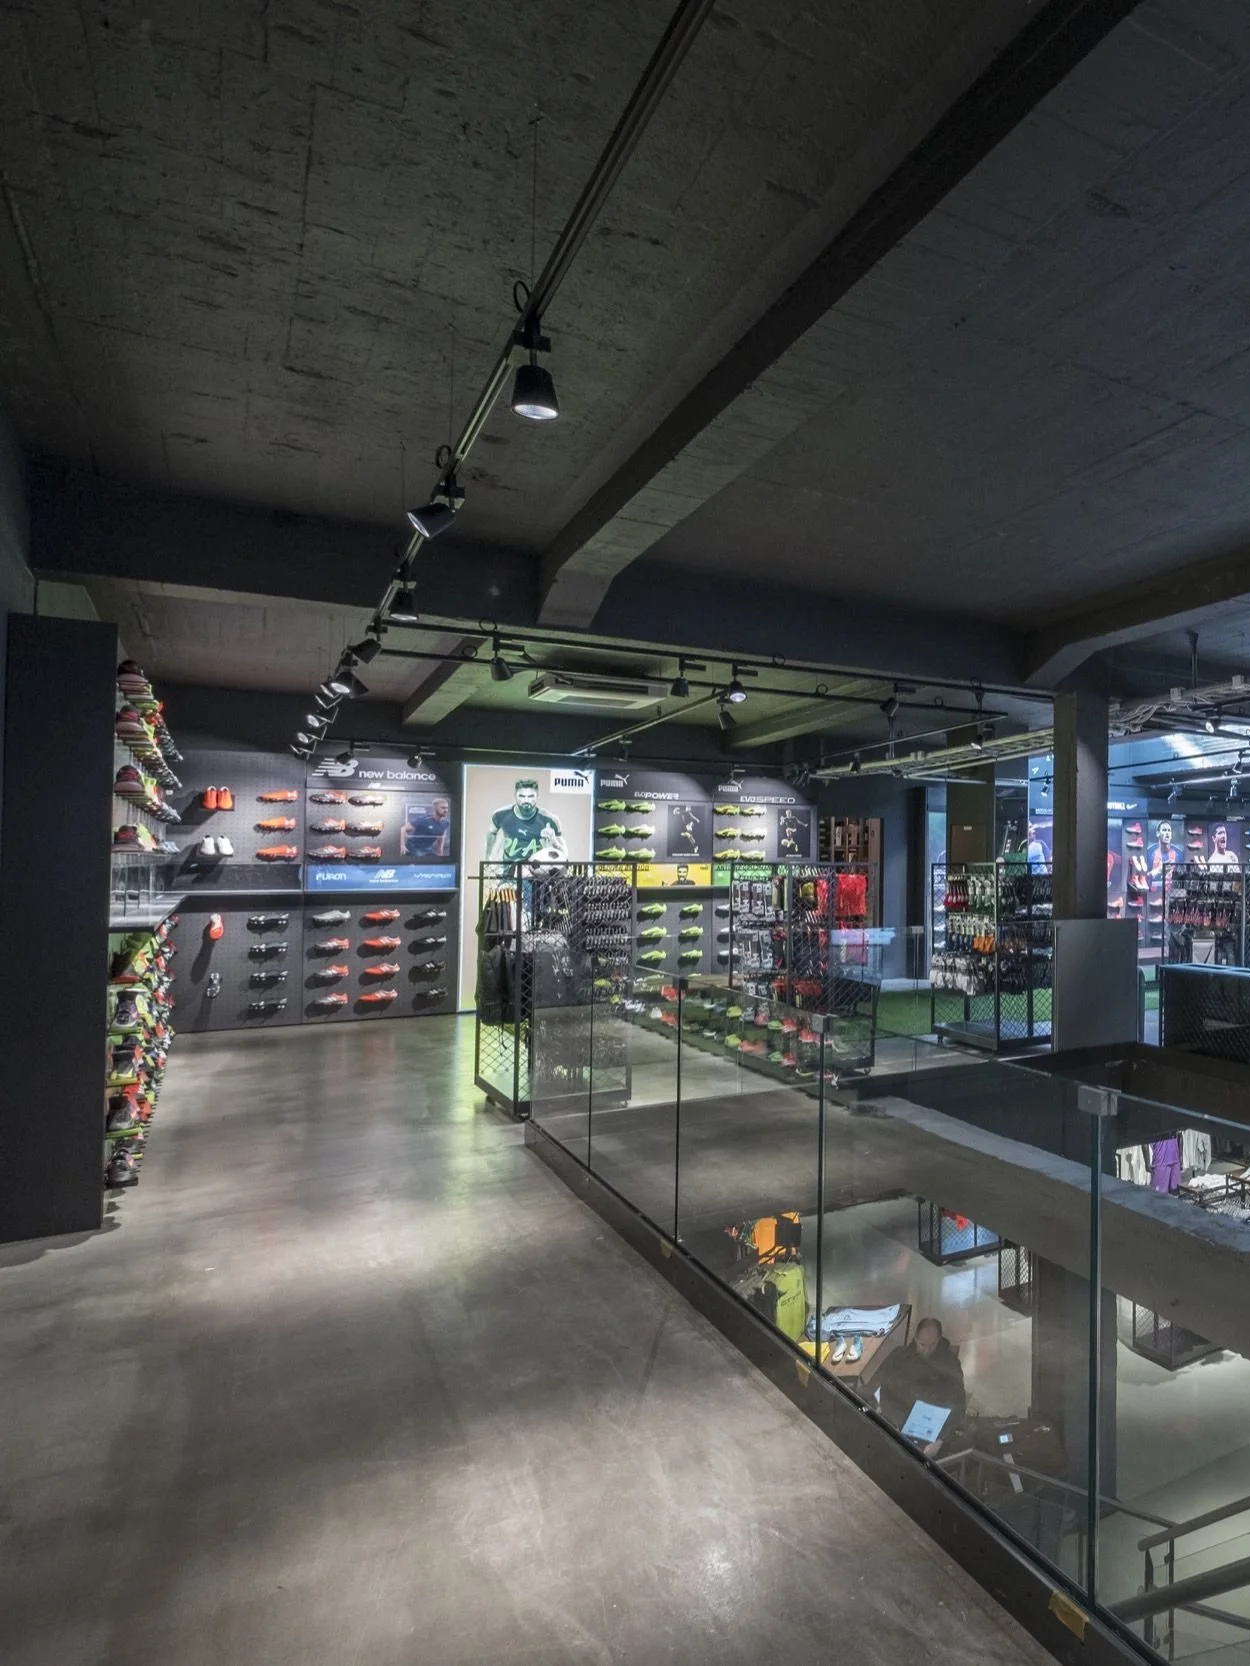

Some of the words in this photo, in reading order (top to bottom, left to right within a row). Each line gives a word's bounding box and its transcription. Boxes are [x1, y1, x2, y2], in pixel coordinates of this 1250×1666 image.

[358, 770, 384, 778] new
[386, 770, 437, 781] balance
[554, 778, 584, 787] PUMA
[600, 779, 624, 788] PUMA
